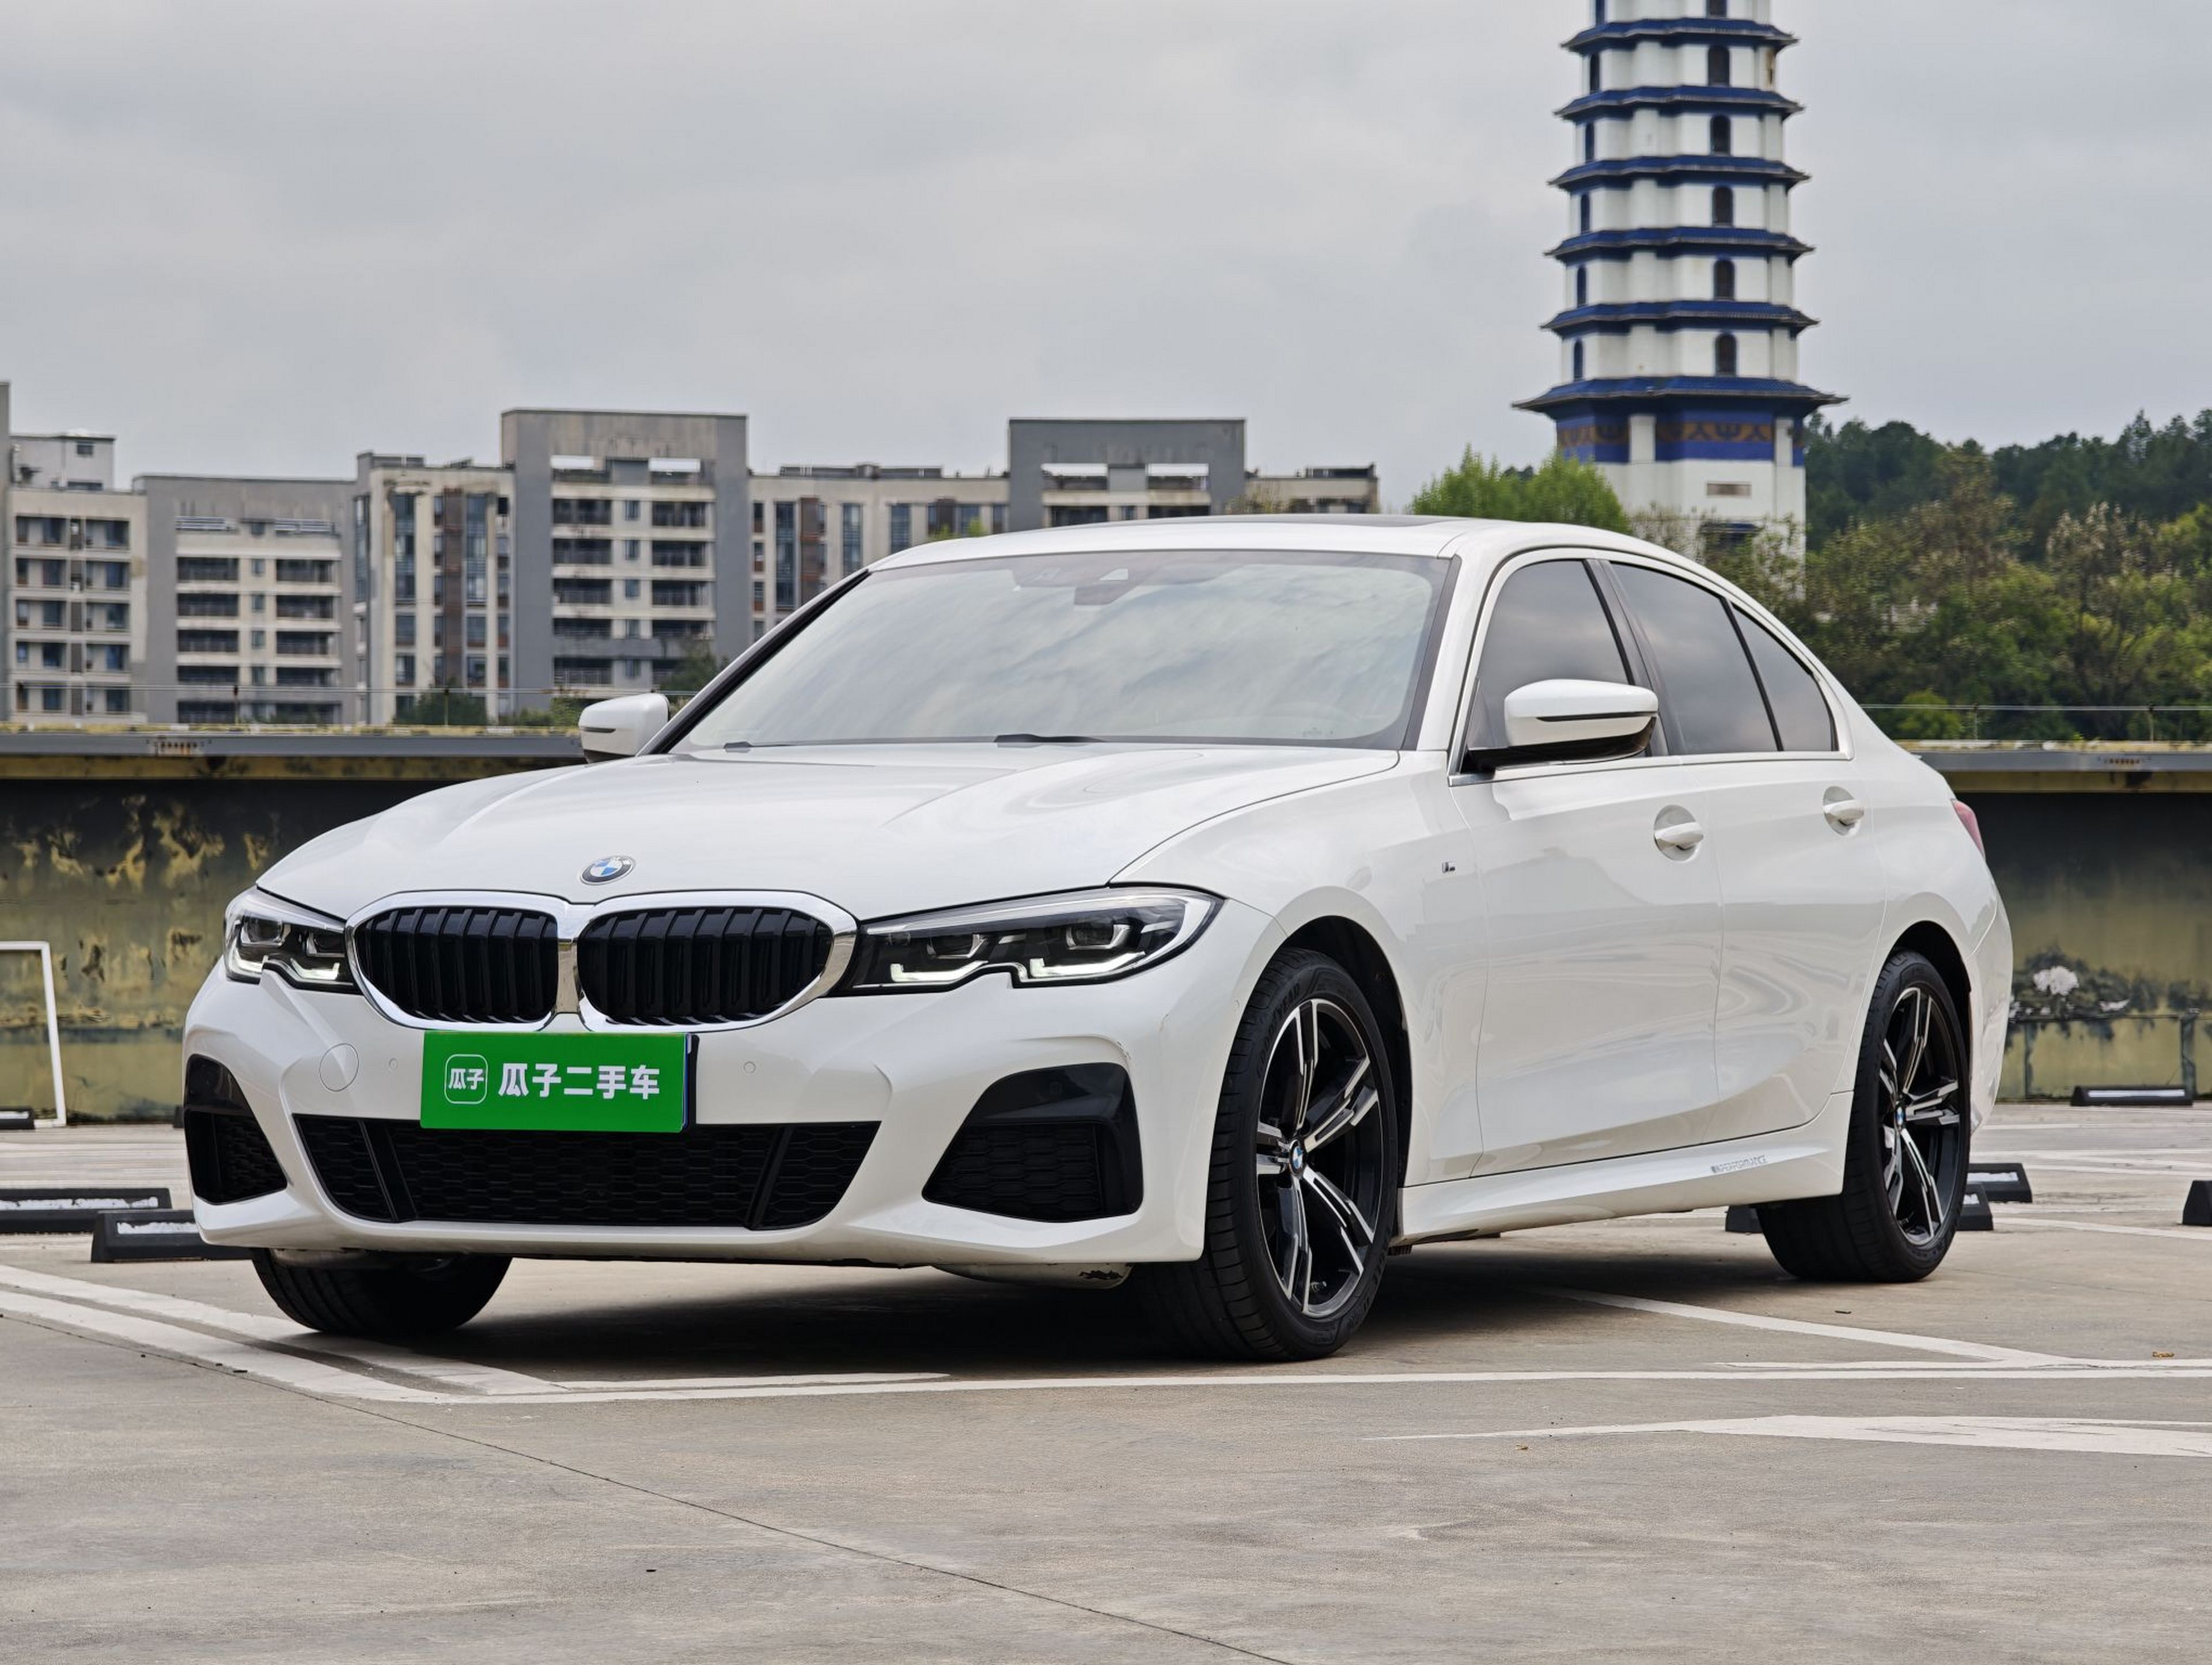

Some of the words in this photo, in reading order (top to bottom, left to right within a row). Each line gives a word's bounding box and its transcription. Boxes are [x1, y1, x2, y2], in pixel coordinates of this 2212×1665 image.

[448, 1068, 484, 1090] 瓜子
[498, 1063, 660, 1100] 瓜子二手车
